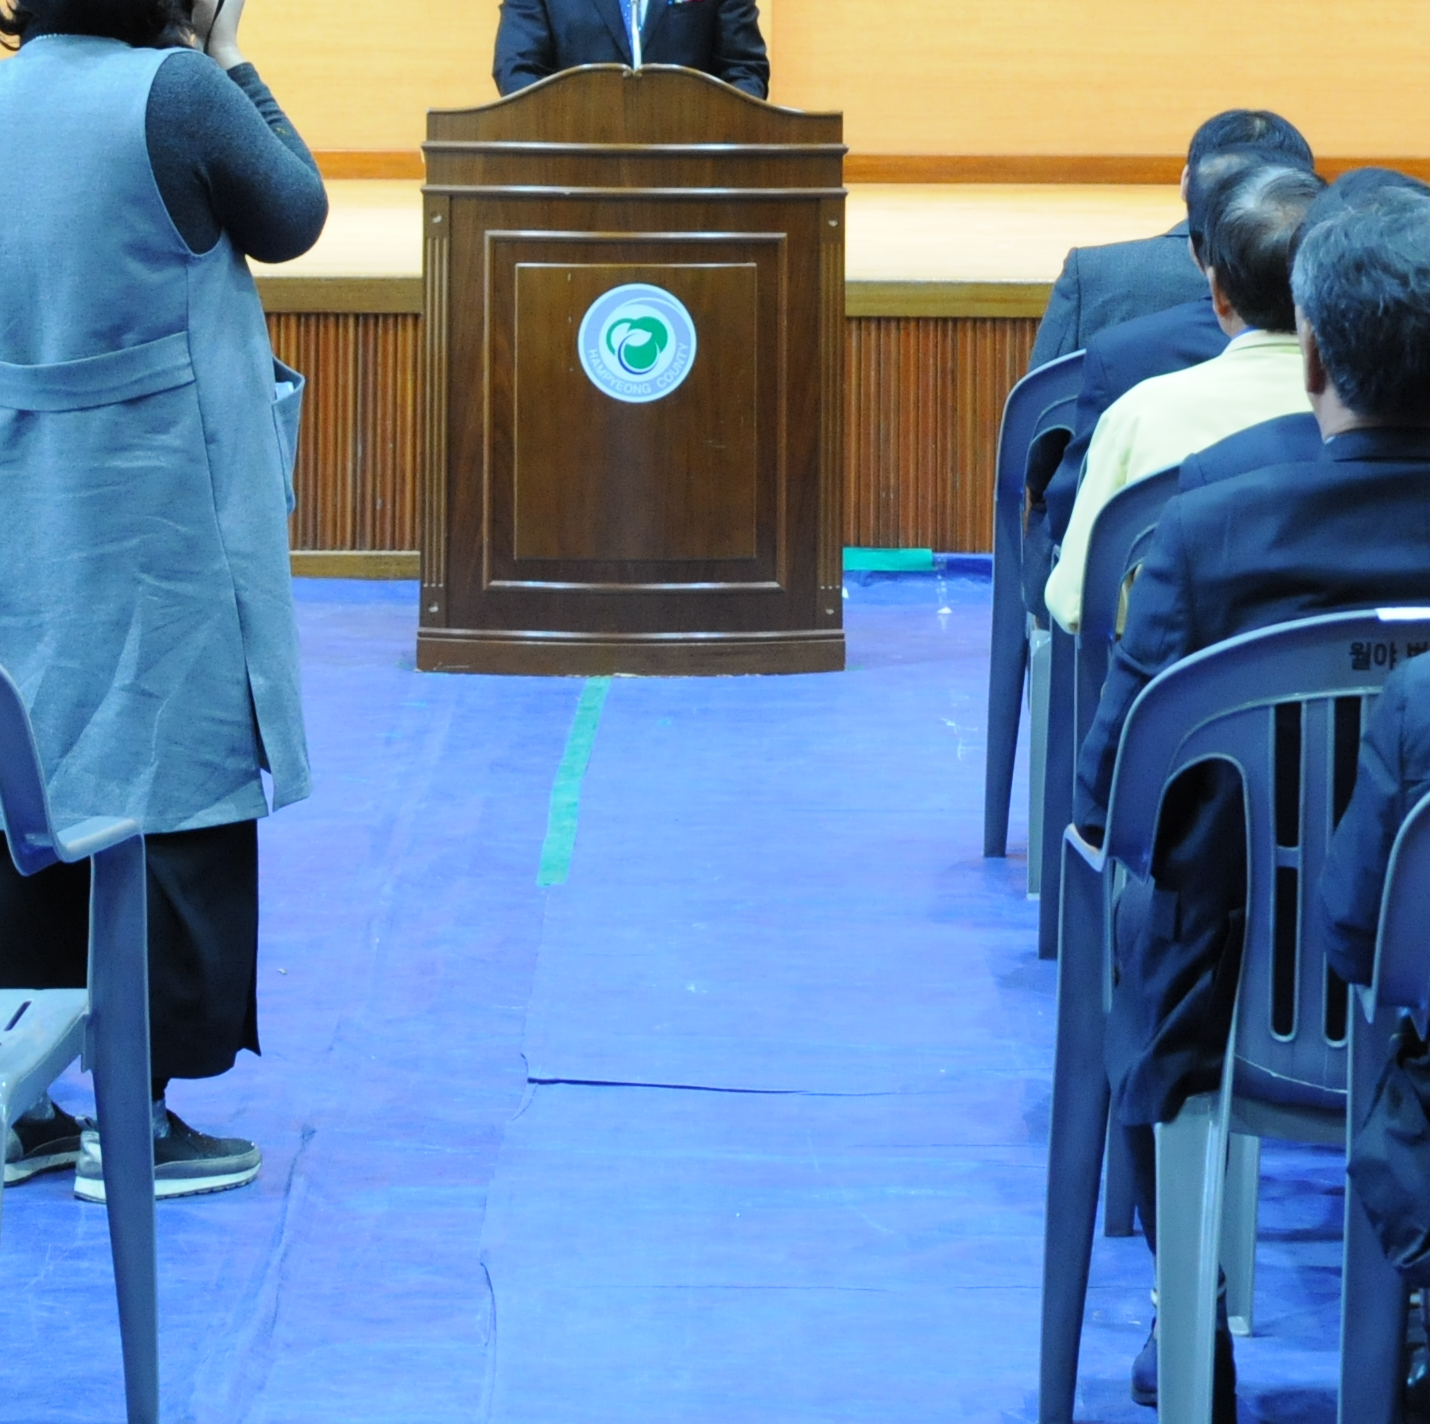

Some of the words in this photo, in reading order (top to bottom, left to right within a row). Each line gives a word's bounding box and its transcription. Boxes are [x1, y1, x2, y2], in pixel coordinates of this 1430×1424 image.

[588, 349, 652, 394] HAMPYEONG
[656, 342, 688, 388] COUNTY
[1350, 641, 1398, 670] 월야
